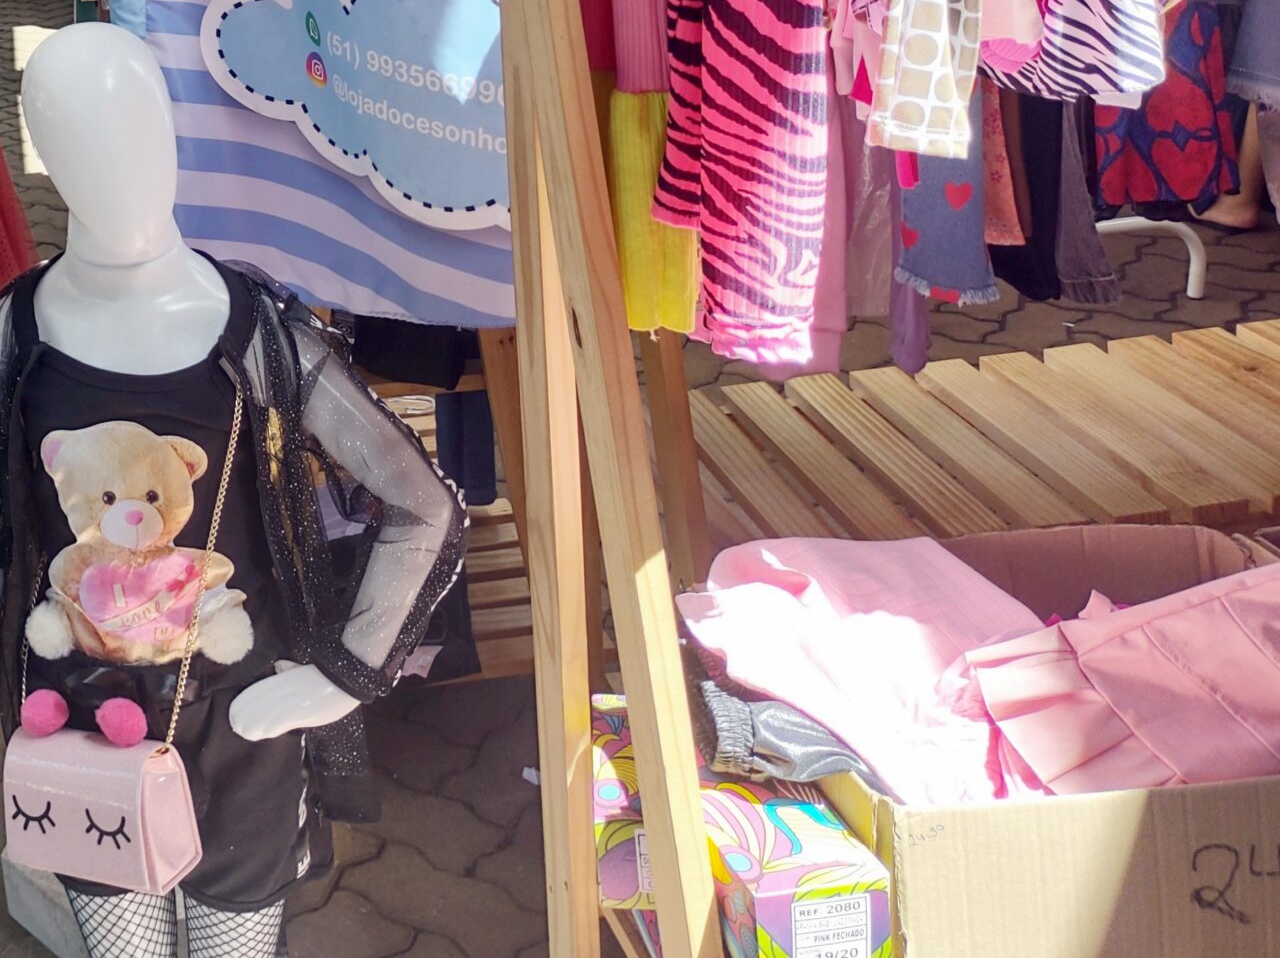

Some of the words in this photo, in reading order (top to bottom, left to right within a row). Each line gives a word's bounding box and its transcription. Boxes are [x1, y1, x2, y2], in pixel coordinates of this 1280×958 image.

[327, 30, 360, 71] (51)
[826, 900, 861, 915] 2080
[813, 933, 831, 943] PINK
[832, 928, 865, 941] FECHADO
